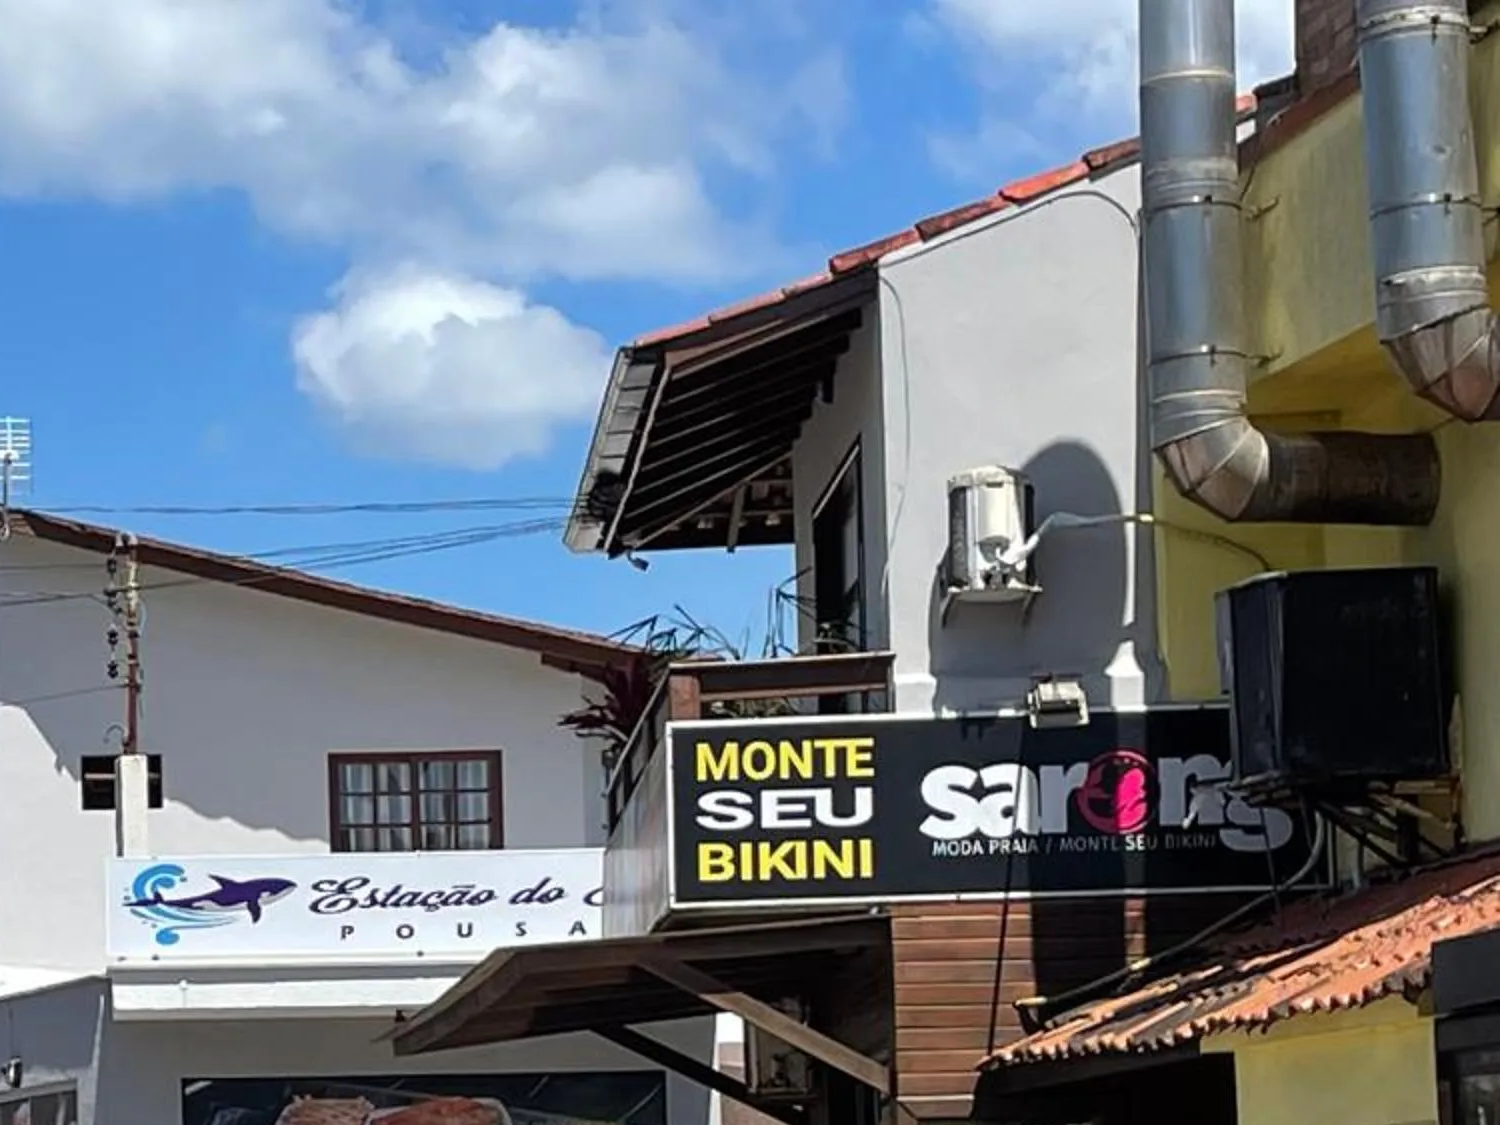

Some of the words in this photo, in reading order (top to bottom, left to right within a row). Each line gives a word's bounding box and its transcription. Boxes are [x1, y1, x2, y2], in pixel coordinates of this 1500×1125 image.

[696, 738, 875, 781] MONTE
[696, 790, 873, 830] SEU
[697, 840, 874, 881] BIKINI
[932, 839, 984, 857] MODA
[988, 838, 1039, 855] PRAIA
[1059, 836, 1120, 853] MONTE
[1124, 834, 1158, 851] SEU
[1165, 832, 1217, 849] BIKINI
[309, 874, 498, 915] Estação
[507, 877, 565, 905] do
[340, 920, 588, 940] POUSA
